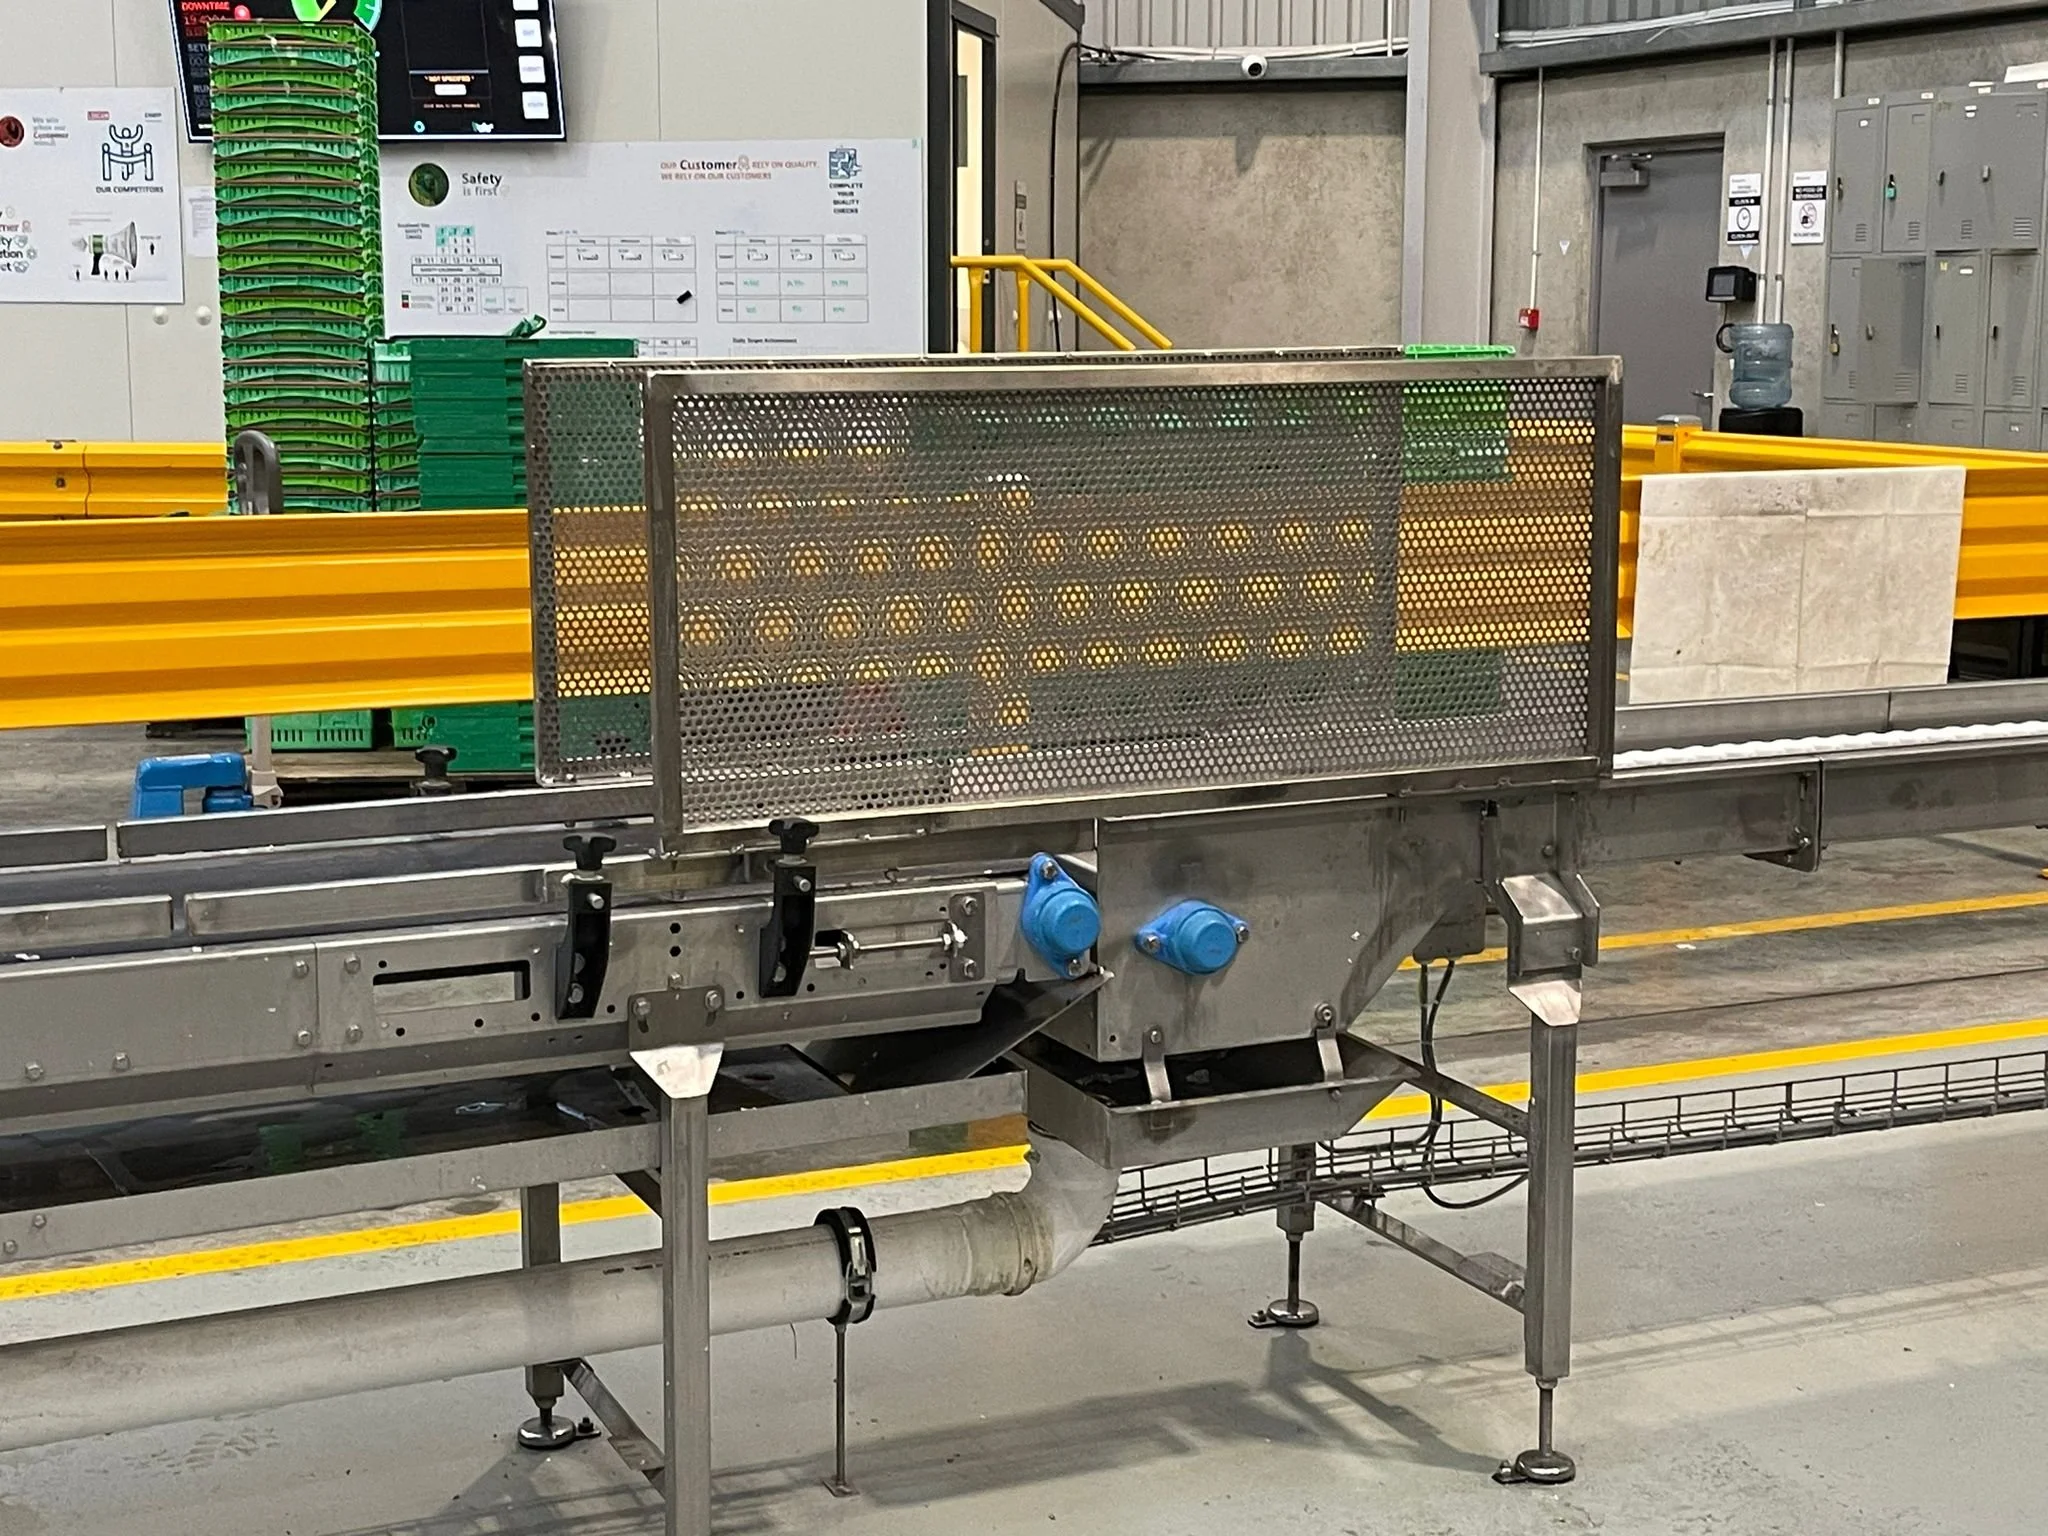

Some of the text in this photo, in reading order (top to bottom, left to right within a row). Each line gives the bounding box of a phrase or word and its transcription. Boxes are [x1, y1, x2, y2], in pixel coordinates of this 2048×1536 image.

[182, 2, 229, 10] DOWNTIME
[680, 159, 737, 170] Customer
[461, 173, 502, 187] Safety
[96, 186, 164, 194] OUR COMPETITORS
[463, 186, 498, 196] is first
